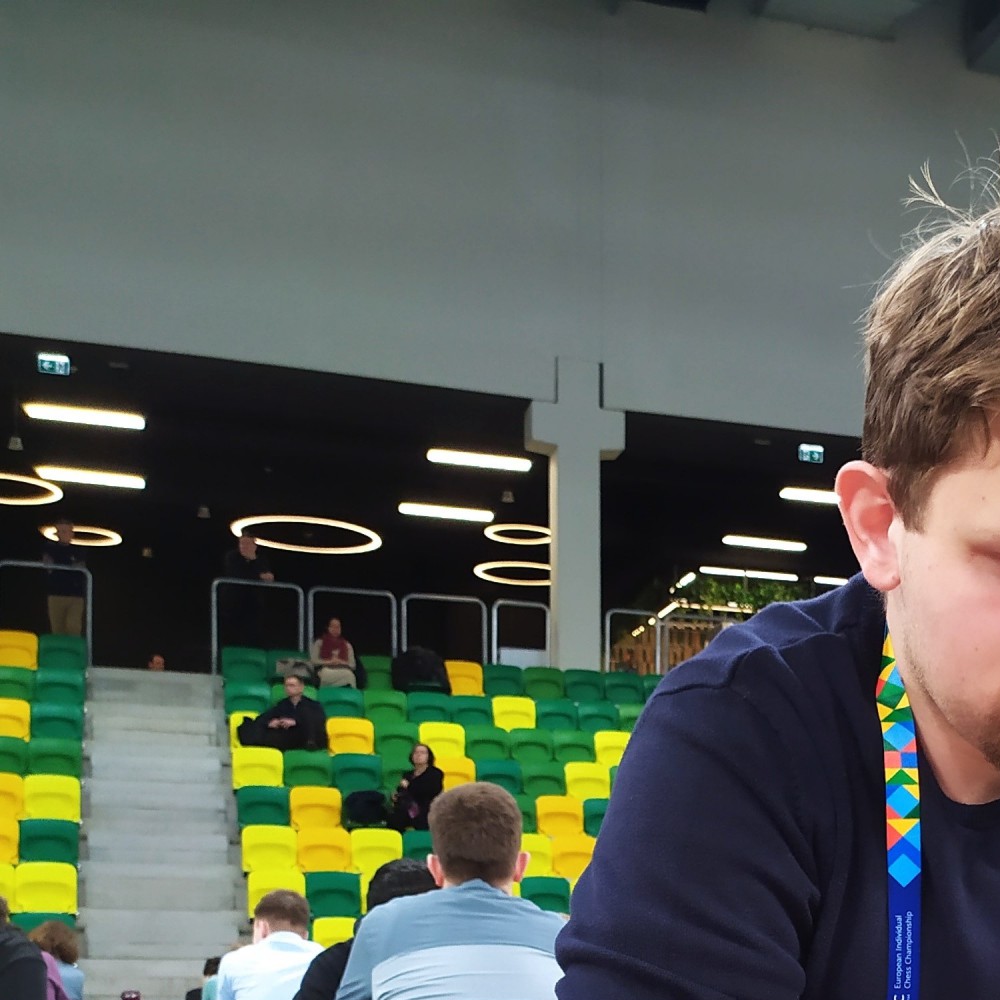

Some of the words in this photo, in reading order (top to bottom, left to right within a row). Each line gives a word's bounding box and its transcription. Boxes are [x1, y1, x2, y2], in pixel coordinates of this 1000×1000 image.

[894, 914, 903, 951] Individual
[904, 911, 914, 965] Championship
[893, 952, 903, 989] European
[903, 966, 912, 989] Chess
